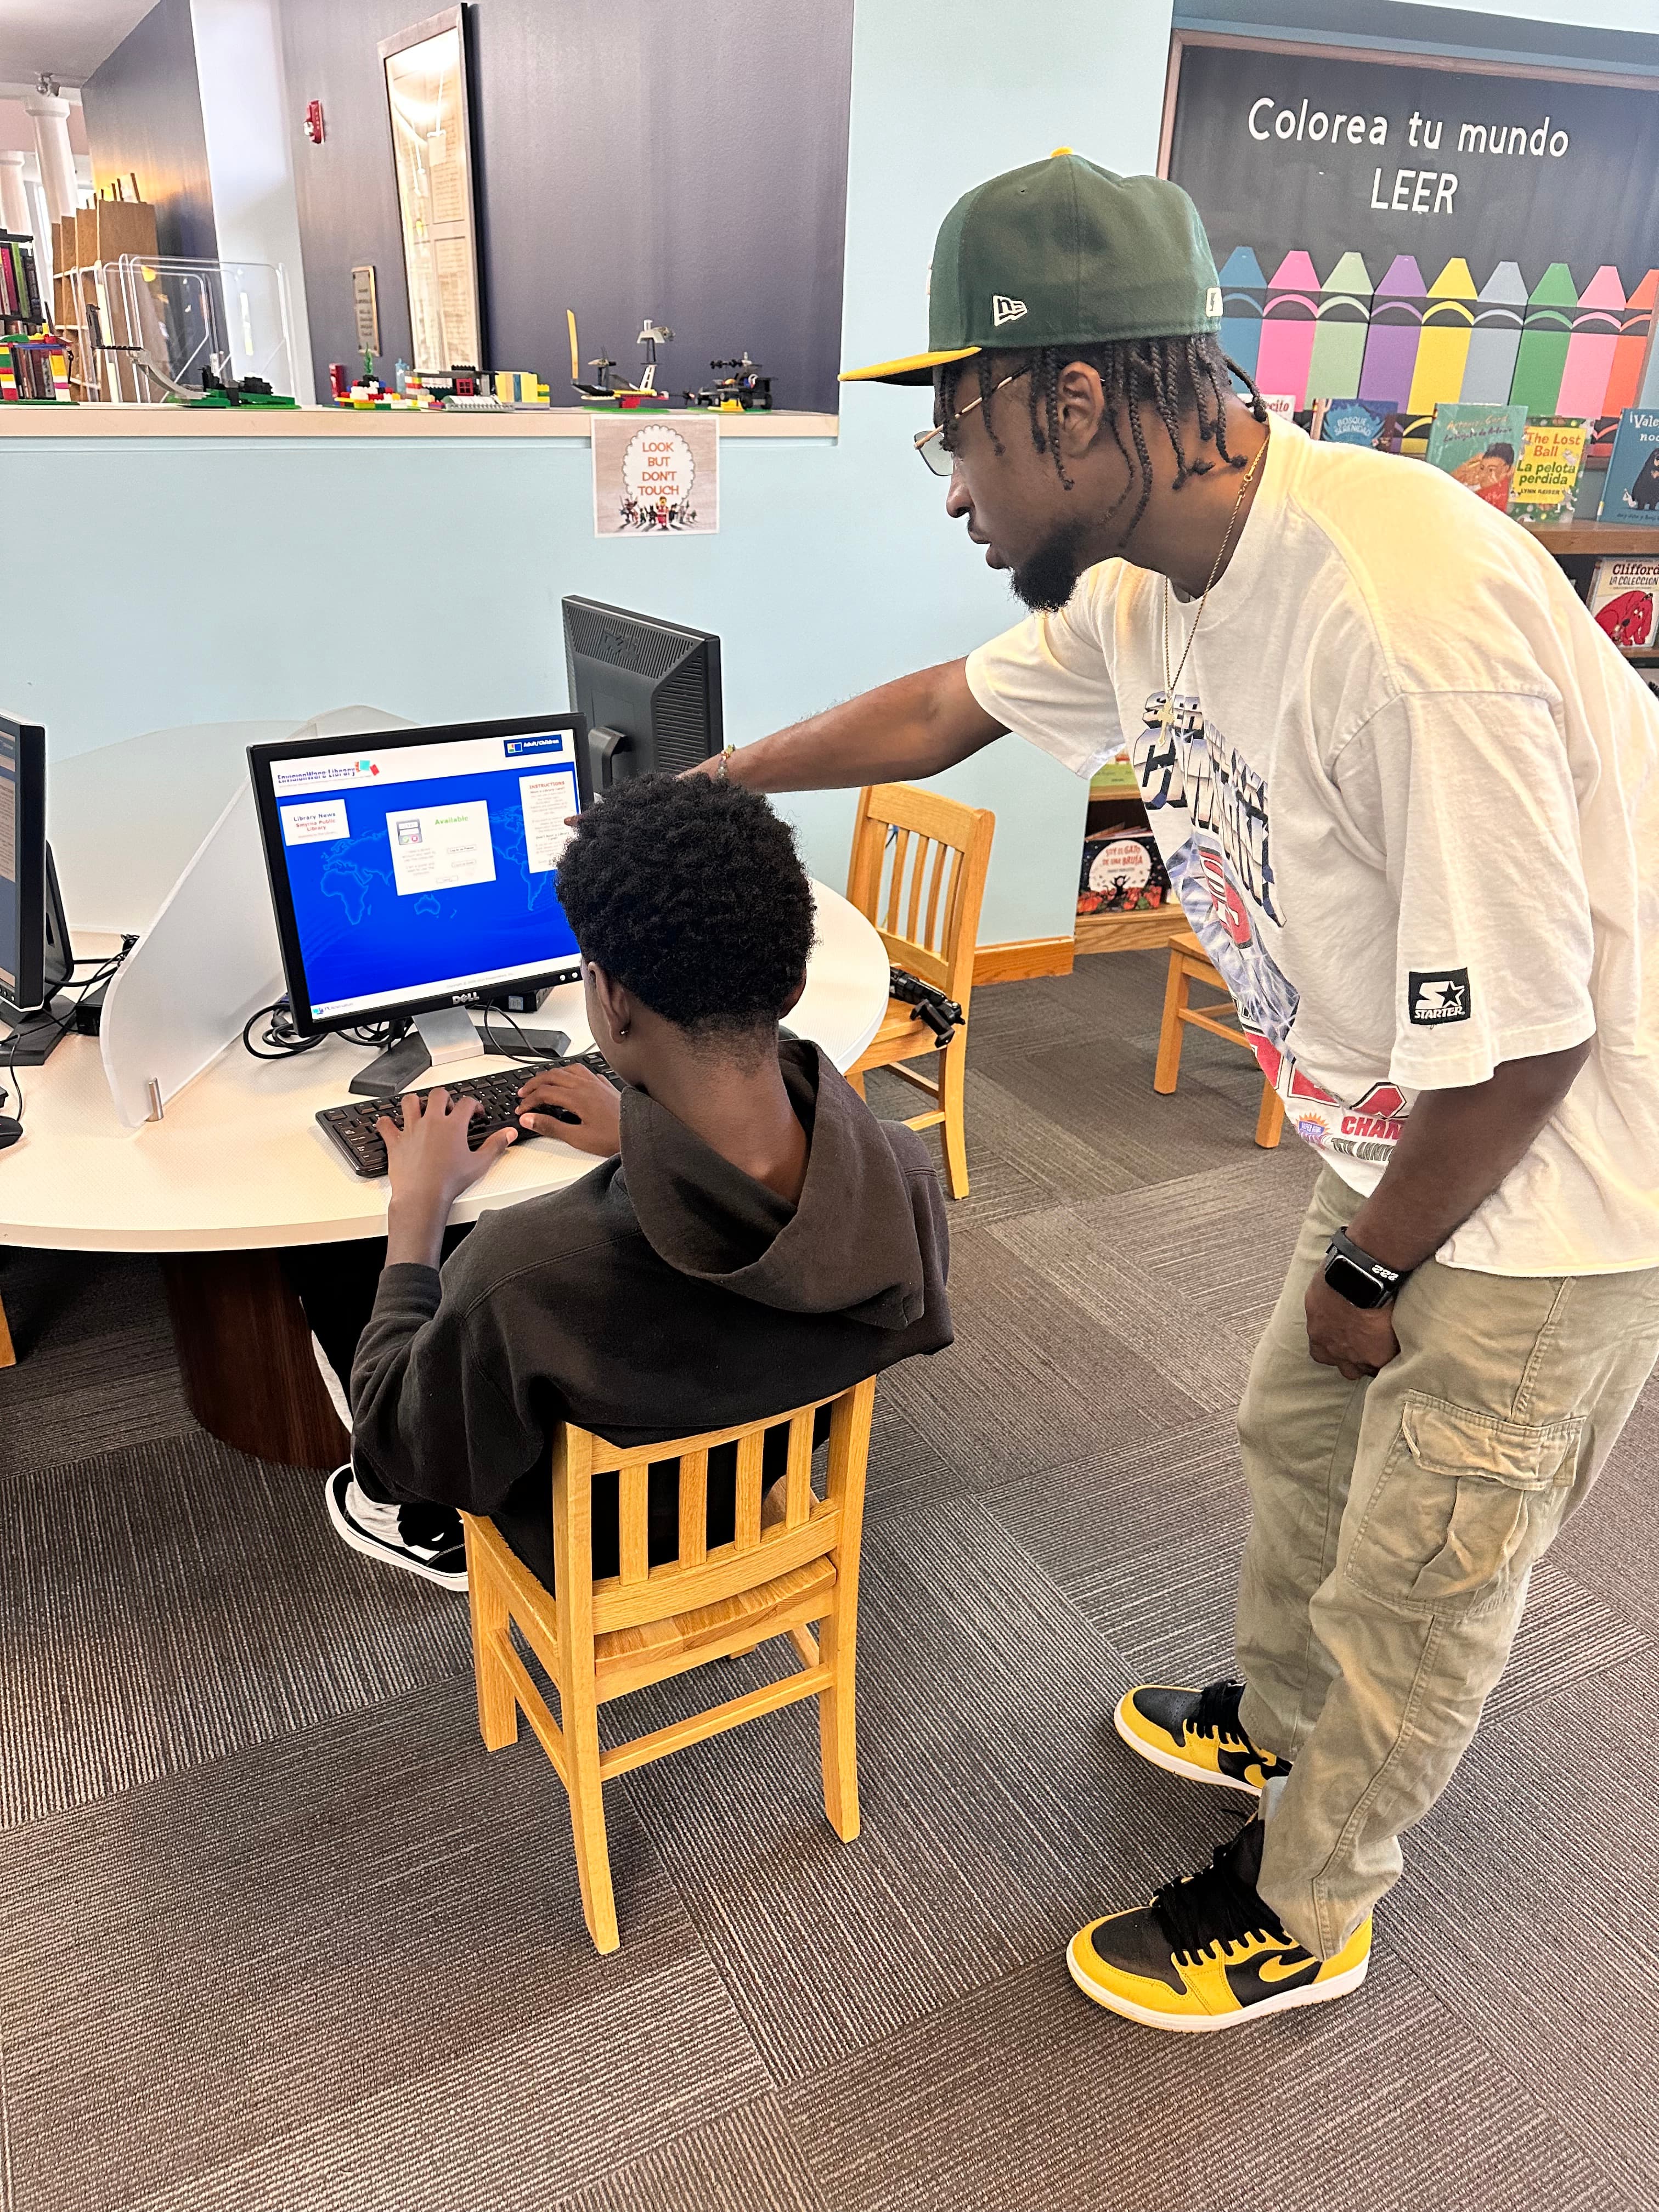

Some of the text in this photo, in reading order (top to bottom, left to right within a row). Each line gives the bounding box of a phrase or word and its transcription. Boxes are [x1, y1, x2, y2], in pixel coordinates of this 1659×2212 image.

[1248, 97, 1569, 157] Colorea tu mundo
[1370, 168, 1458, 215] LEER
[1527, 432, 1581, 445] The Lost
[642, 442, 674, 453] LOOK
[1533, 445, 1559, 457] Ball
[647, 456, 671, 467] BUT
[1517, 460, 1576, 475] La pelota
[642, 471, 677, 482] DON'T
[1519, 473, 1568, 486] perdida
[637, 485, 680, 495] TOUCH
[1612, 563, 1659, 575] Clifford
[1609, 575, 1618, 585] LA
[328, 768, 356, 778] Library
[529, 781, 565, 789] INSTRUCTIONS
[435, 815, 469, 825] Available
[452, 991, 480, 1005] DELL
[1414, 1006, 1463, 1019] STARTER
